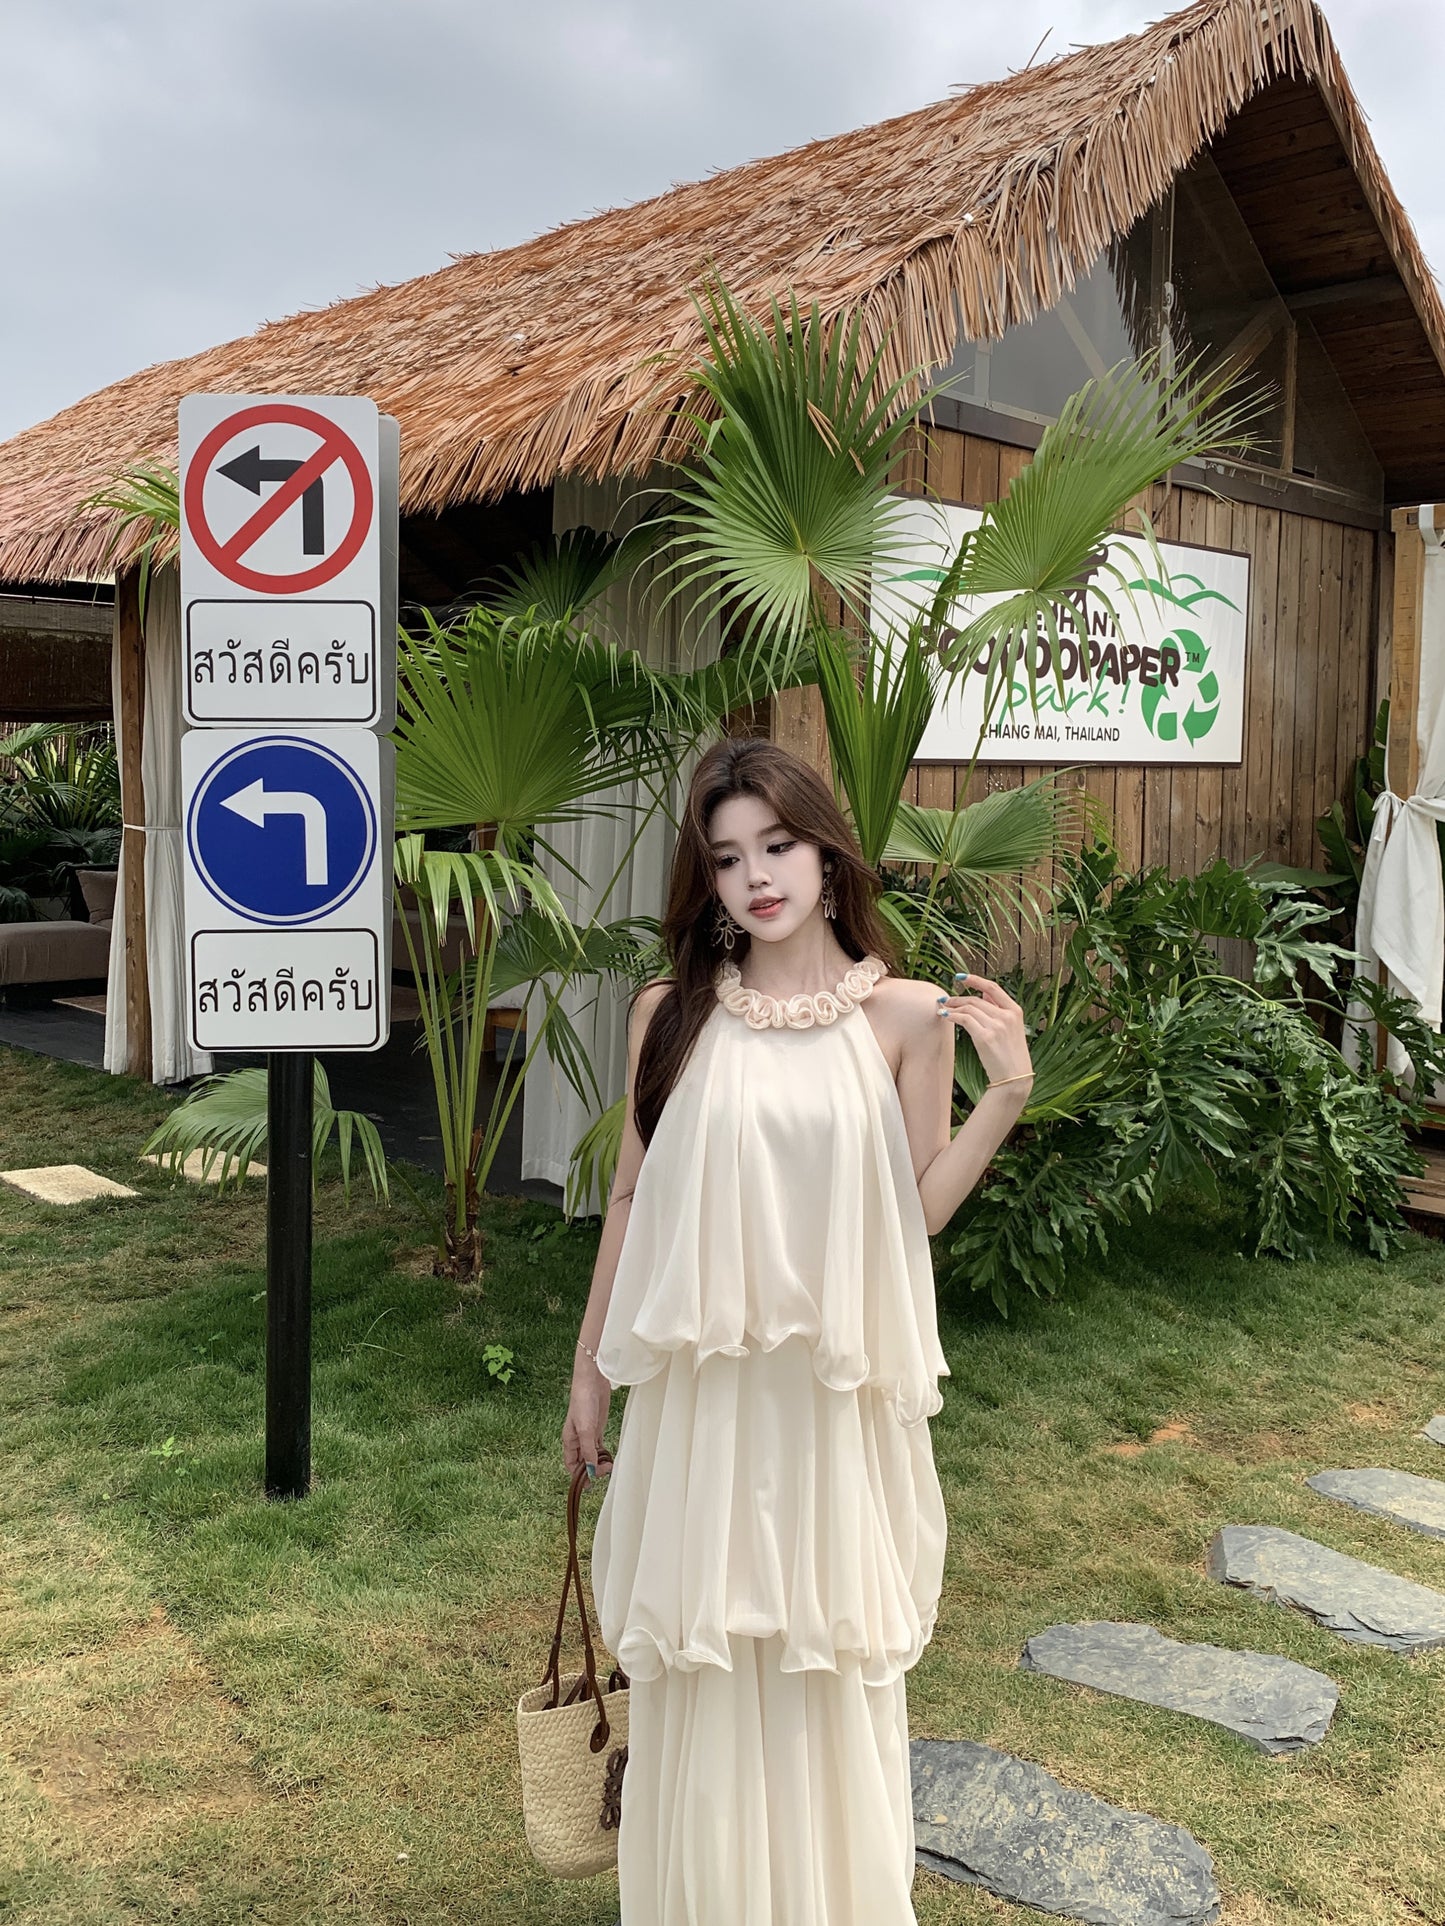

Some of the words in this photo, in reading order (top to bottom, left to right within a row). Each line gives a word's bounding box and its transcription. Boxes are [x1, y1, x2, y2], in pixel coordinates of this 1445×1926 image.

[194, 638, 369, 684] สวัสดีครับ
[996, 660, 1132, 734] park!
[1034, 725, 1060, 742] MAI,
[1065, 726, 1120, 742] THAILAND
[199, 966, 372, 1012] สวัสดีครับ
